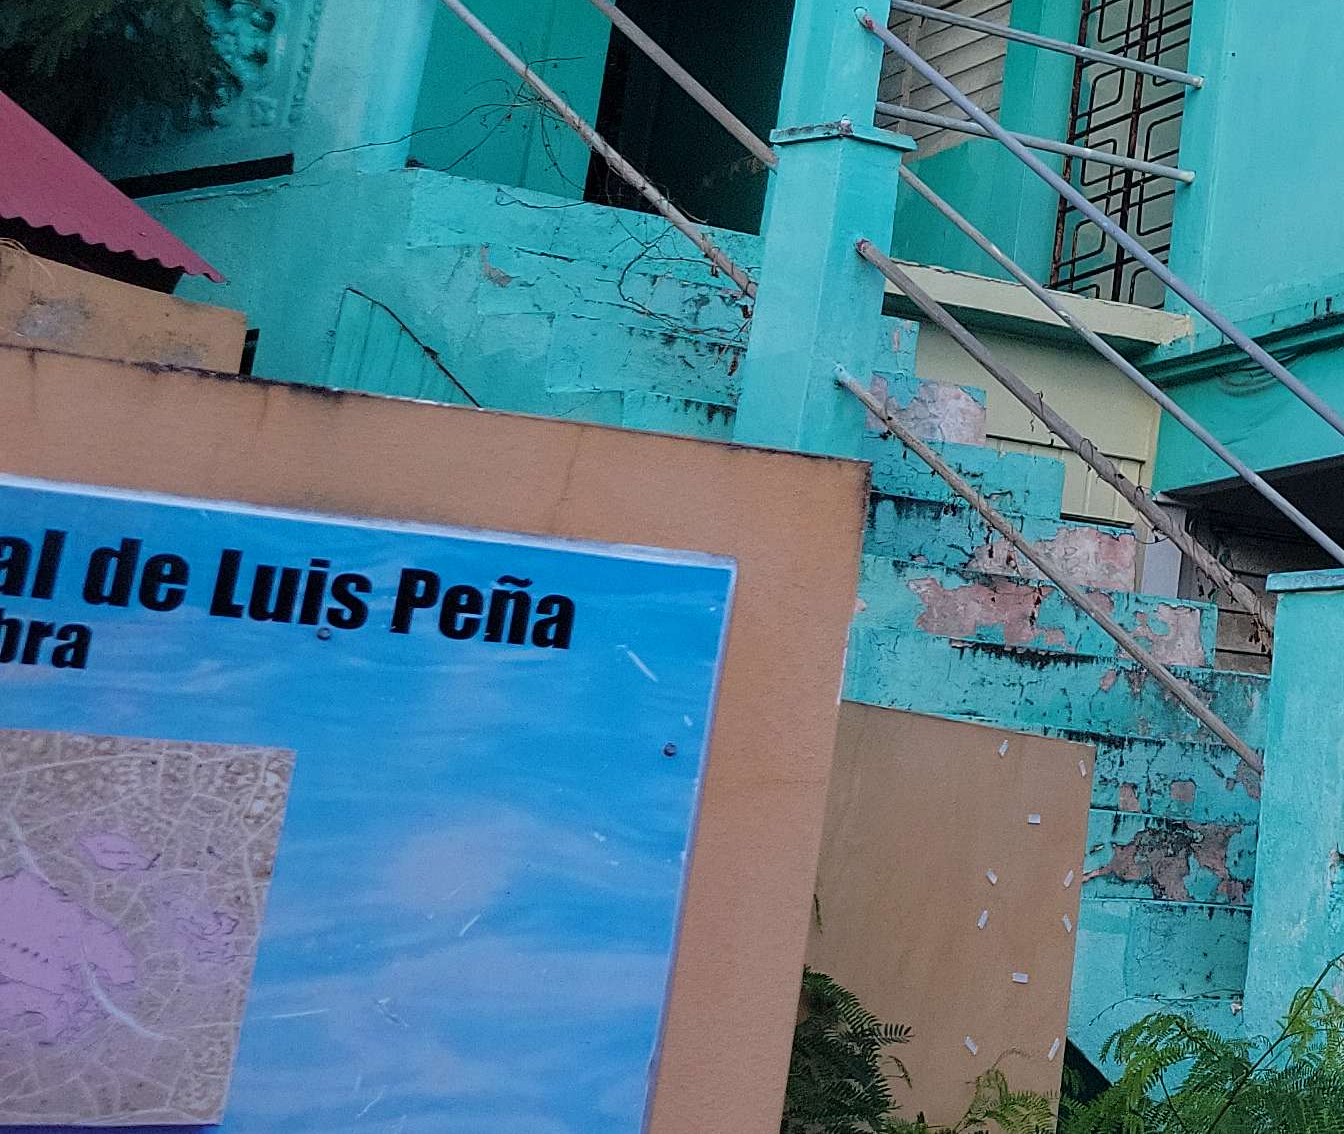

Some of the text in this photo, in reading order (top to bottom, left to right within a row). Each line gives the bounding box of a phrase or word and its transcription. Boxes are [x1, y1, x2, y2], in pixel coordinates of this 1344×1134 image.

[82, 537, 190, 612] de
[209, 548, 372, 632] Luis
[392, 568, 576, 650] Peña
